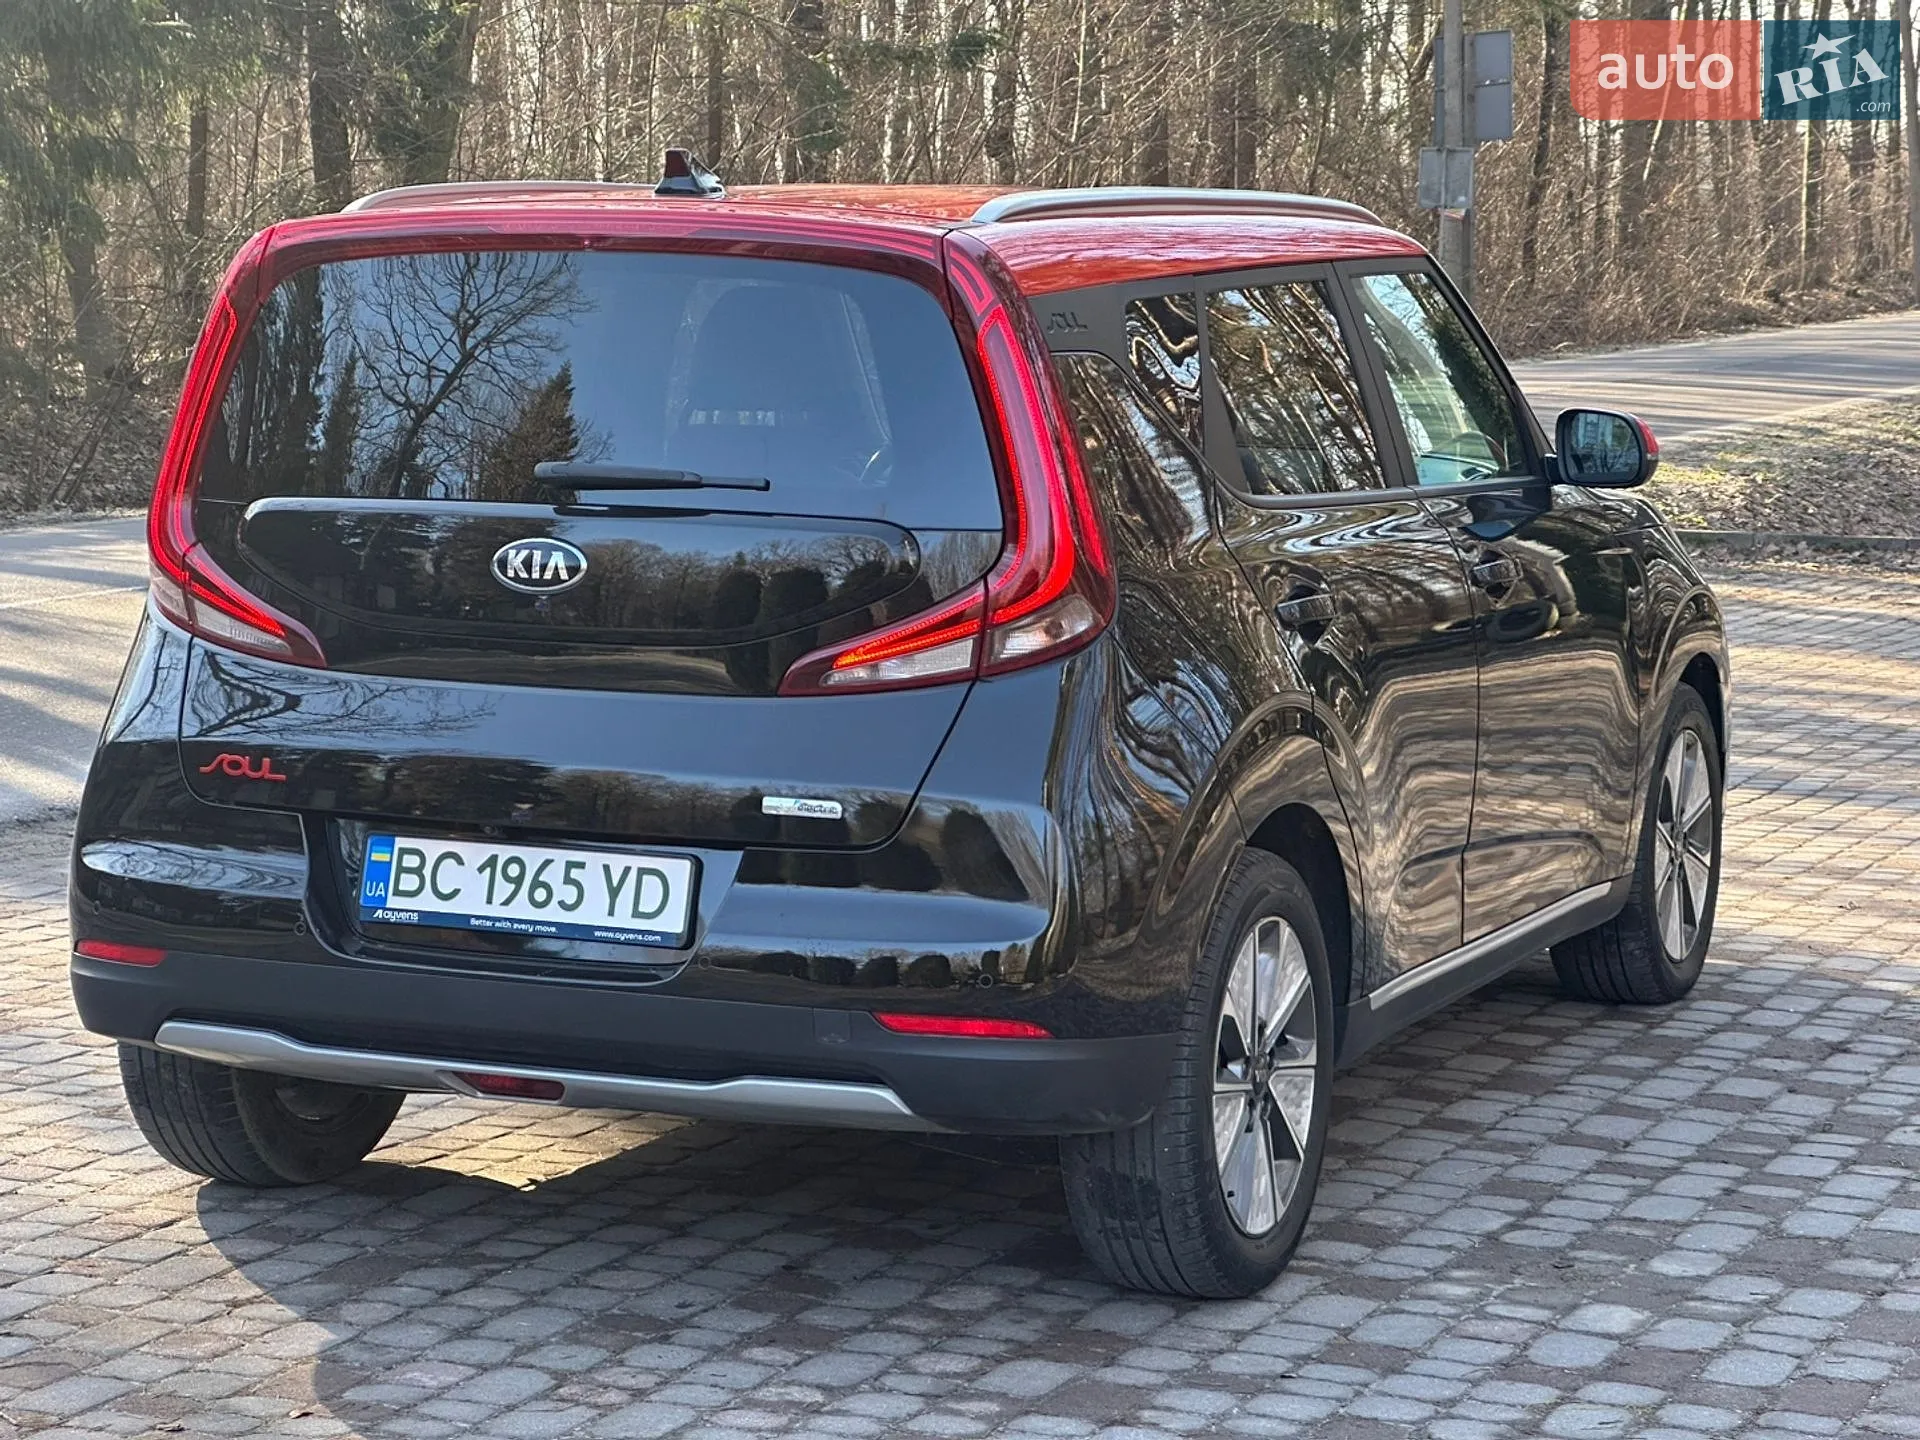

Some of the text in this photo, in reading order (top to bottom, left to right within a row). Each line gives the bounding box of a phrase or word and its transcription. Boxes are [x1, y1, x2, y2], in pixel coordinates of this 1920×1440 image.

[506, 549, 569, 580] KIA
[365, 879, 386, 898] UA
[391, 847, 670, 920] BC 1965 YD
[470, 917, 493, 927] Better
[513, 923, 533, 933] every
[594, 930, 662, 942] www.ayvens.com
